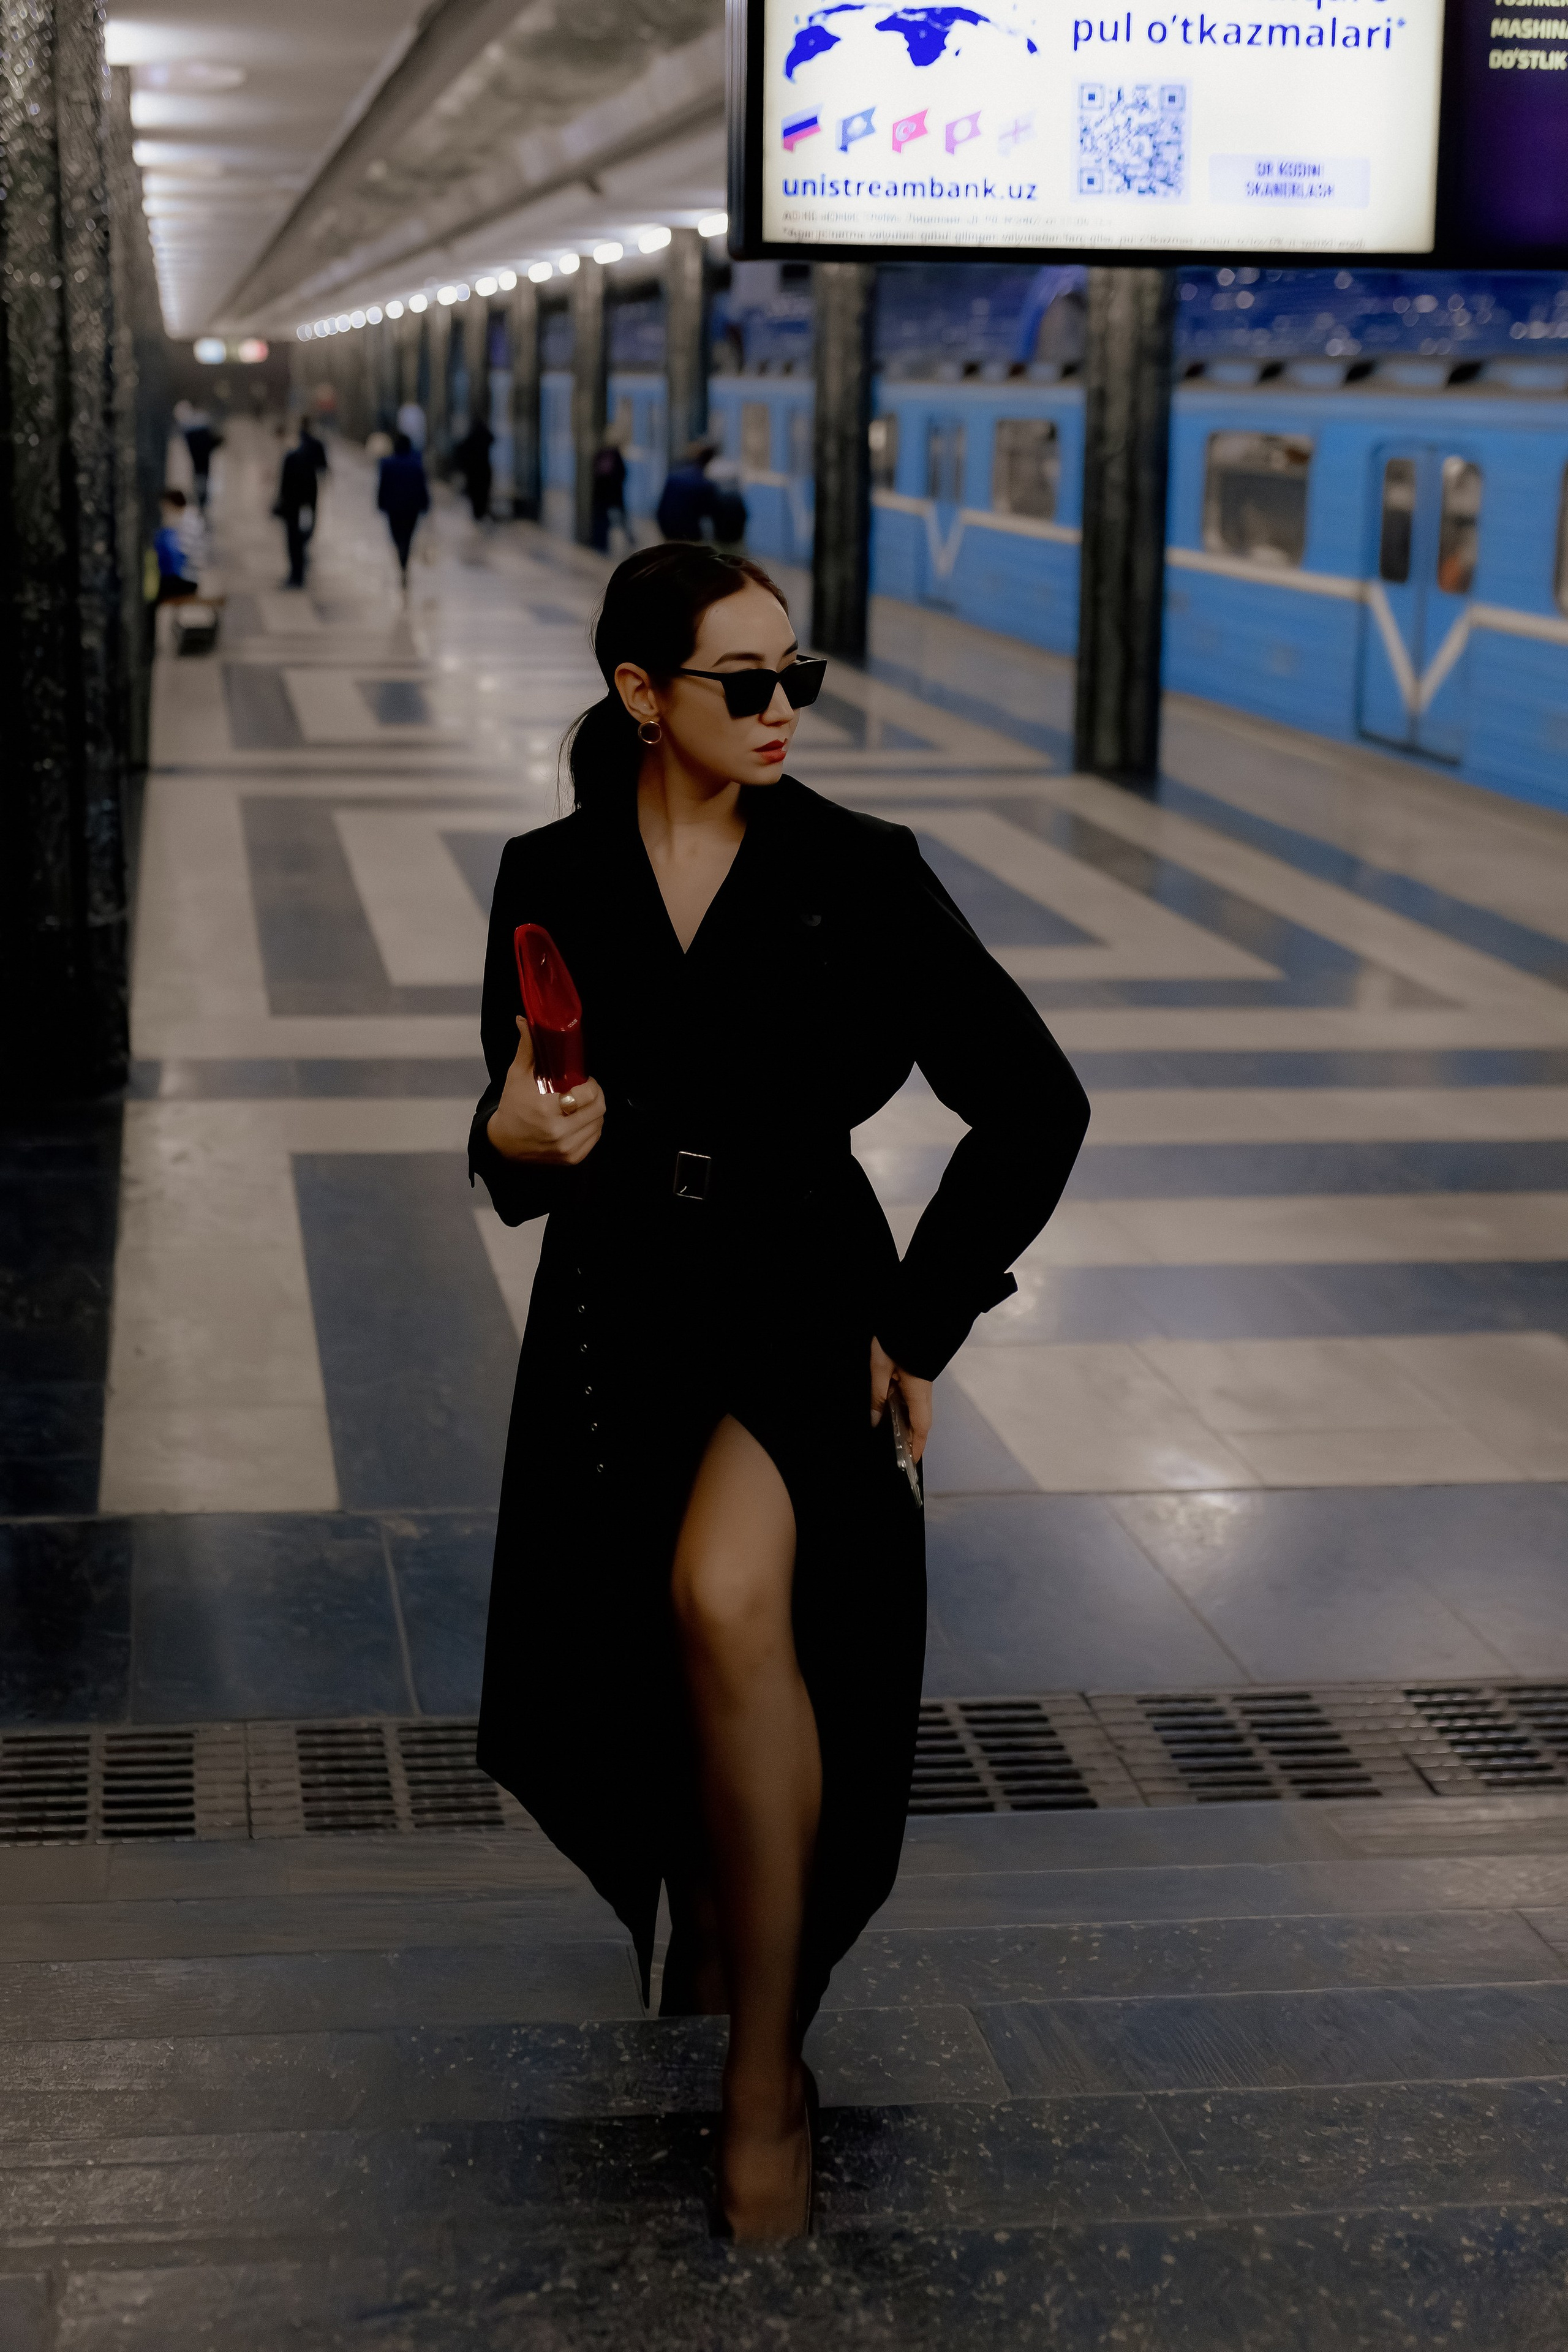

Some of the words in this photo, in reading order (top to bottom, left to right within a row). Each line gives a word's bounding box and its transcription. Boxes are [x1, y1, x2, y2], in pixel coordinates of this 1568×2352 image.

[1073, 12, 1131, 51] pul
[1490, 18, 1568, 39] MASHIN
[782, 174, 1038, 200] unistreambank.uz
